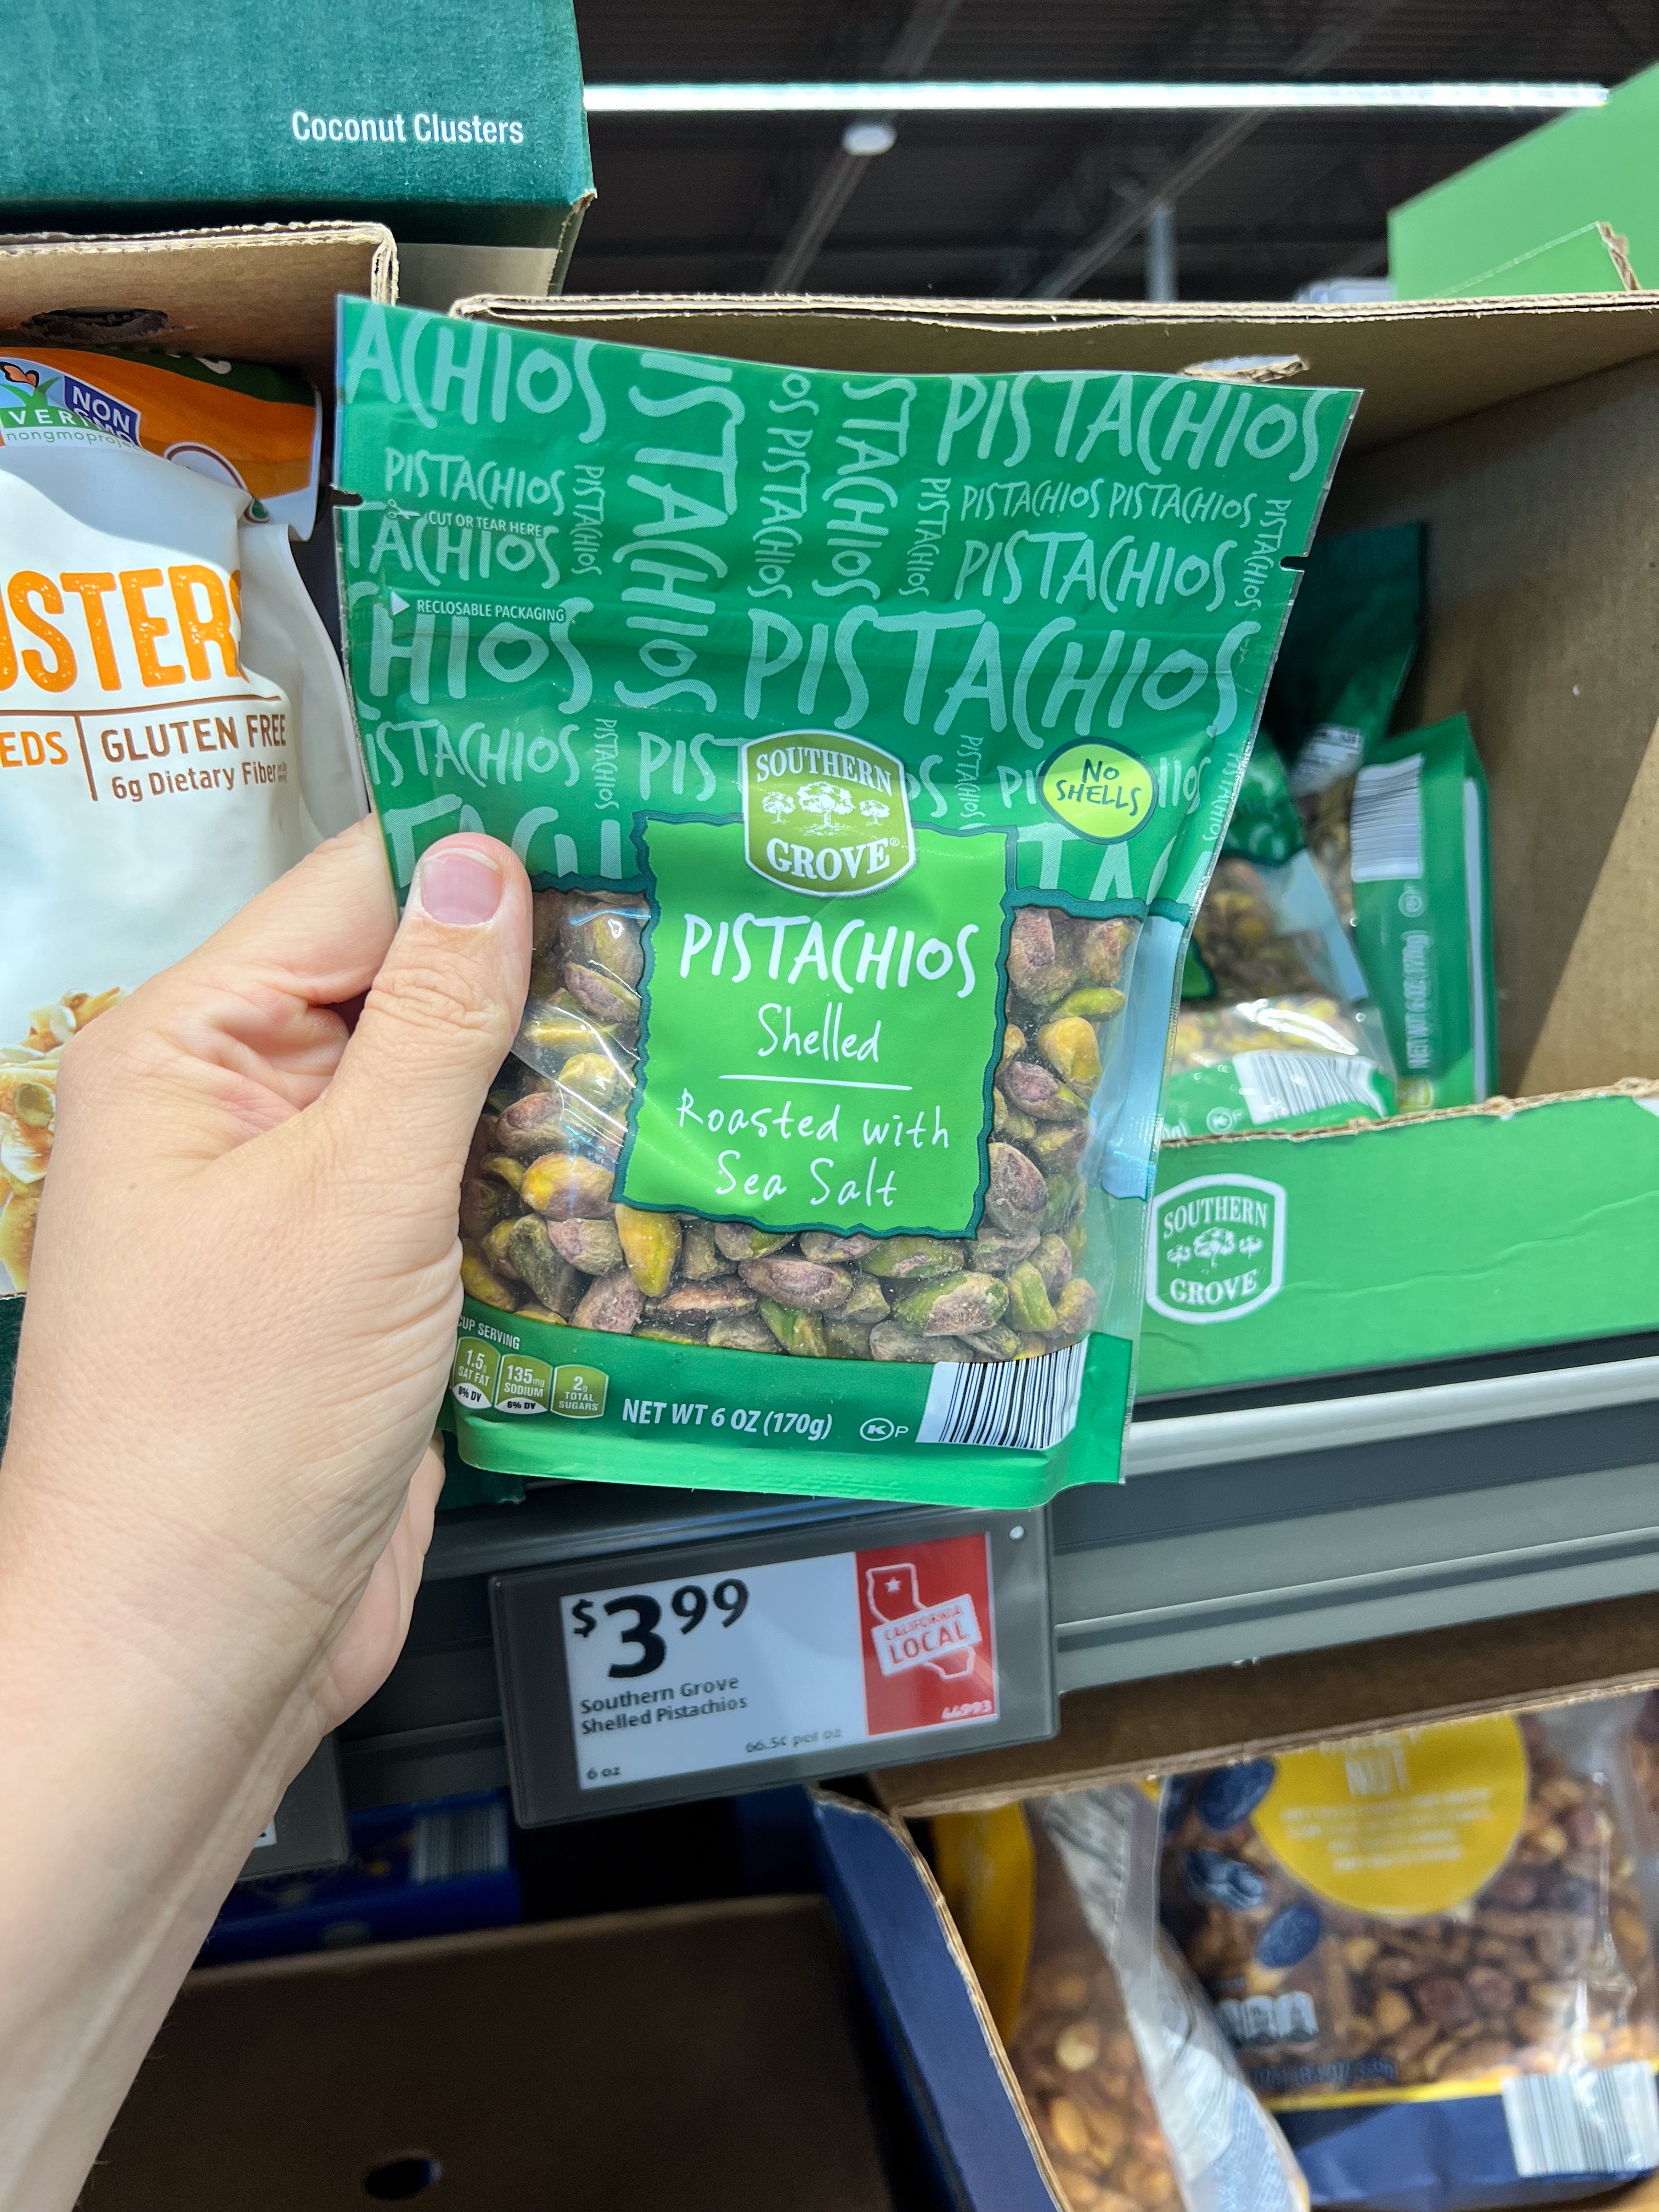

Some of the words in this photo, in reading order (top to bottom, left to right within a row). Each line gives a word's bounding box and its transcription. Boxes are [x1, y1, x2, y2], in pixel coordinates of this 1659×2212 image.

[292, 111, 405, 143] Coconut
[414, 112, 524, 144] Clusters
[73, 386, 130, 434] NON
[937, 374, 1339, 482] PISTACHIOS
[386, 447, 566, 517] PISTACHIOS
[960, 478, 1105, 522] PISTACHIOS
[1108, 482, 1257, 528] PISTACHIOS
[428, 511, 453, 526] CUT
[455, 514, 473, 528] OR
[476, 517, 506, 532] TEAR
[509, 521, 542, 537] HERE
[569, 465, 605, 575] PISTACHIOS
[747, 428, 814, 599] PISTACHIOS
[898, 478, 952, 597] PISTACHIOS
[1234, 499, 1293, 608] PISTACHIOS
[953, 529, 1238, 613] PISTACHIOS
[416, 599, 492, 617] RECLOSABLE
[495, 604, 565, 623] PACKAGING
[744, 605, 1261, 749] PISTACHIOS
[101, 716, 238, 763] GLUTEN
[245, 714, 287, 748] FREE
[111, 775, 143, 803] 6g
[150, 766, 235, 796] Dietary
[242, 761, 276, 785] Fiber
[594, 718, 619, 809] PISTACHIOS
[755, 746, 892, 797] SOUTHERN
[956, 735, 986, 819] PISTACHIOS
[1081, 758, 1120, 784] NO
[1056, 779, 1142, 817] SHELLS
[679, 912, 979, 998] PISTACHIOS
[758, 1002, 882, 1063] Shelled
[676, 1087, 840, 1142] Roasted
[862, 1105, 949, 1148] with
[715, 1149, 787, 1201] Sea
[810, 1156, 898, 1207] Salt
[1163, 1194, 1269, 1240] SOUTHERN
[1169, 1267, 1259, 1306] GROVE
[477, 1322, 521, 1351] SERVING
[458, 1365, 473, 1381] SAT
[474, 1372, 490, 1387] FAT
[470, 1391, 482, 1402] DV
[504, 1382, 544, 1398] SODIUM
[565, 1391, 595, 1402] TOTAL
[523, 1402, 536, 1410] DV
[558, 1400, 599, 1412] SUGARS
[622, 1398, 667, 1424] NET
[672, 1403, 708, 1425] WT
[711, 1407, 726, 1427] 6
[730, 1408, 761, 1433] OZ
[763, 1410, 832, 1441] (170g)
[888, 1620, 970, 1664] LOCAL
[579, 1687, 675, 1714] Southern
[680, 1677, 740, 1697] Grove
[580, 1709, 652, 1735] Shelled
[656, 1696, 748, 1723] Pistachios
[586, 1767, 598, 1780] 6
[601, 1765, 621, 1777] oz
